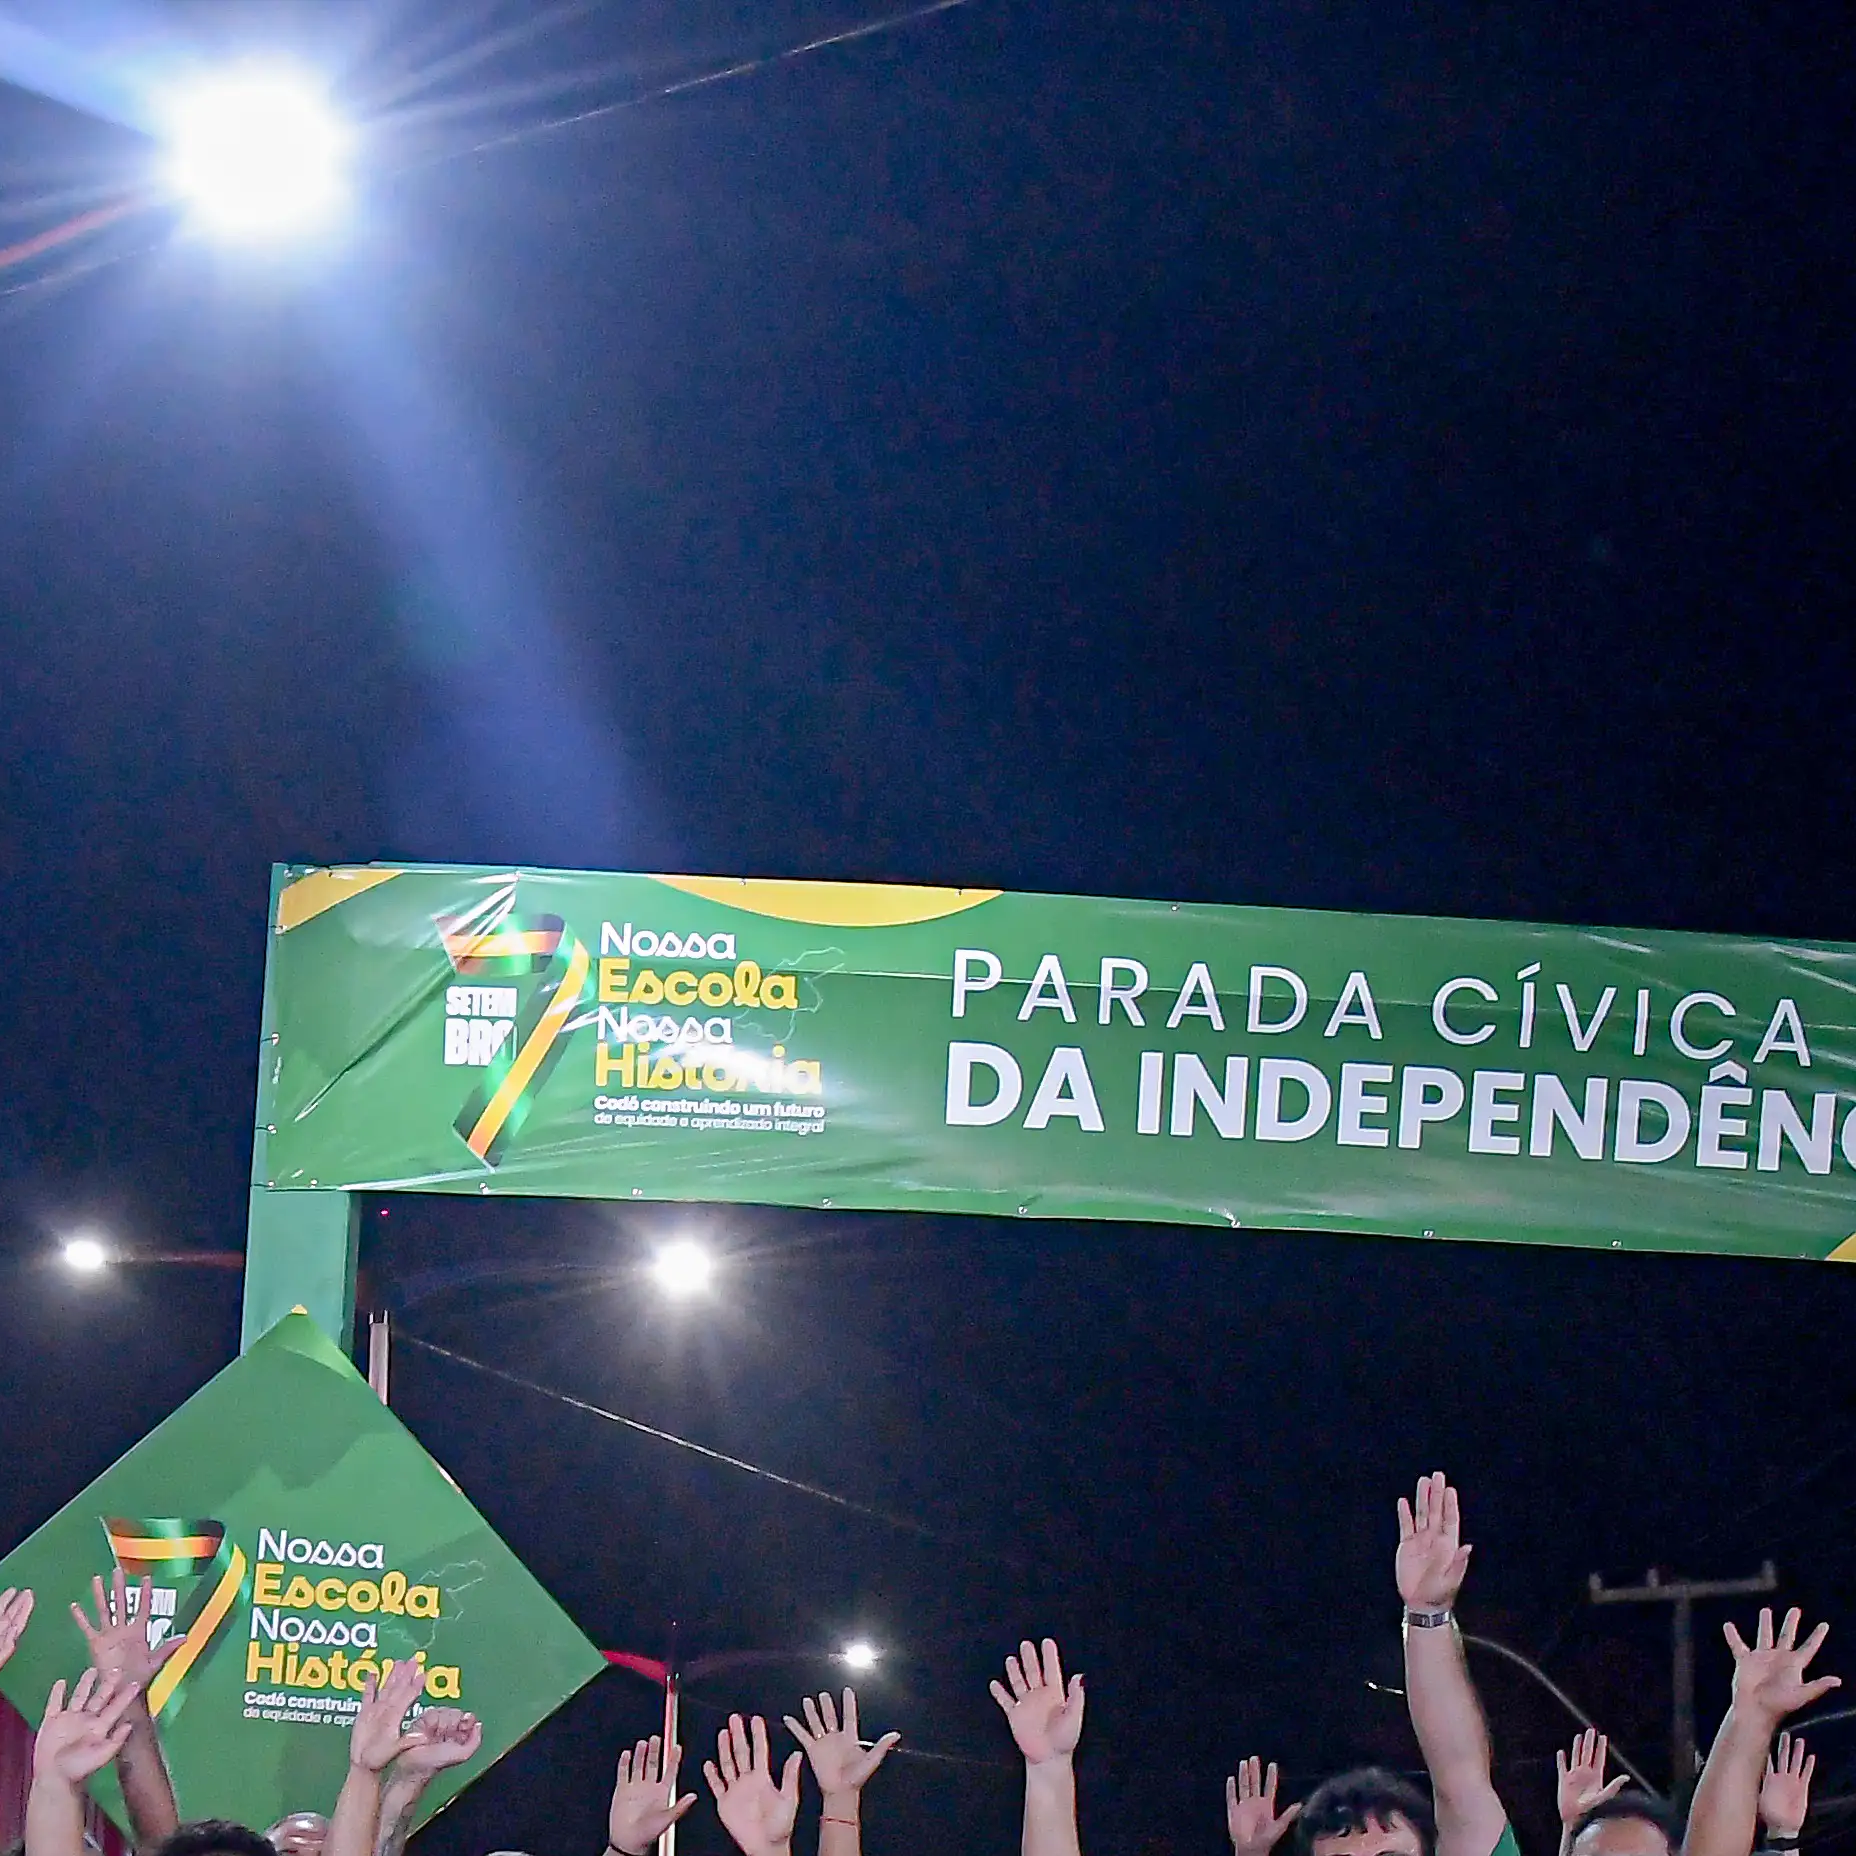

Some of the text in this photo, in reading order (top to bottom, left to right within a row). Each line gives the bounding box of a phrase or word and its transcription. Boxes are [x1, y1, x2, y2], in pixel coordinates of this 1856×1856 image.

[599, 922, 736, 959] Nossa
[598, 958, 799, 1009] Escola
[596, 1006, 733, 1044] Nossa
[950, 948, 1815, 1069] PARADA CÍVICA
[595, 1096, 825, 1119] Codó construindo um futuro
[945, 1040, 1107, 1134] DA
[258, 1529, 385, 1569] Nossa
[253, 1563, 441, 1619] Escola
[250, 1607, 378, 1649] Nossa
[244, 1691, 362, 1712] Codó construin
